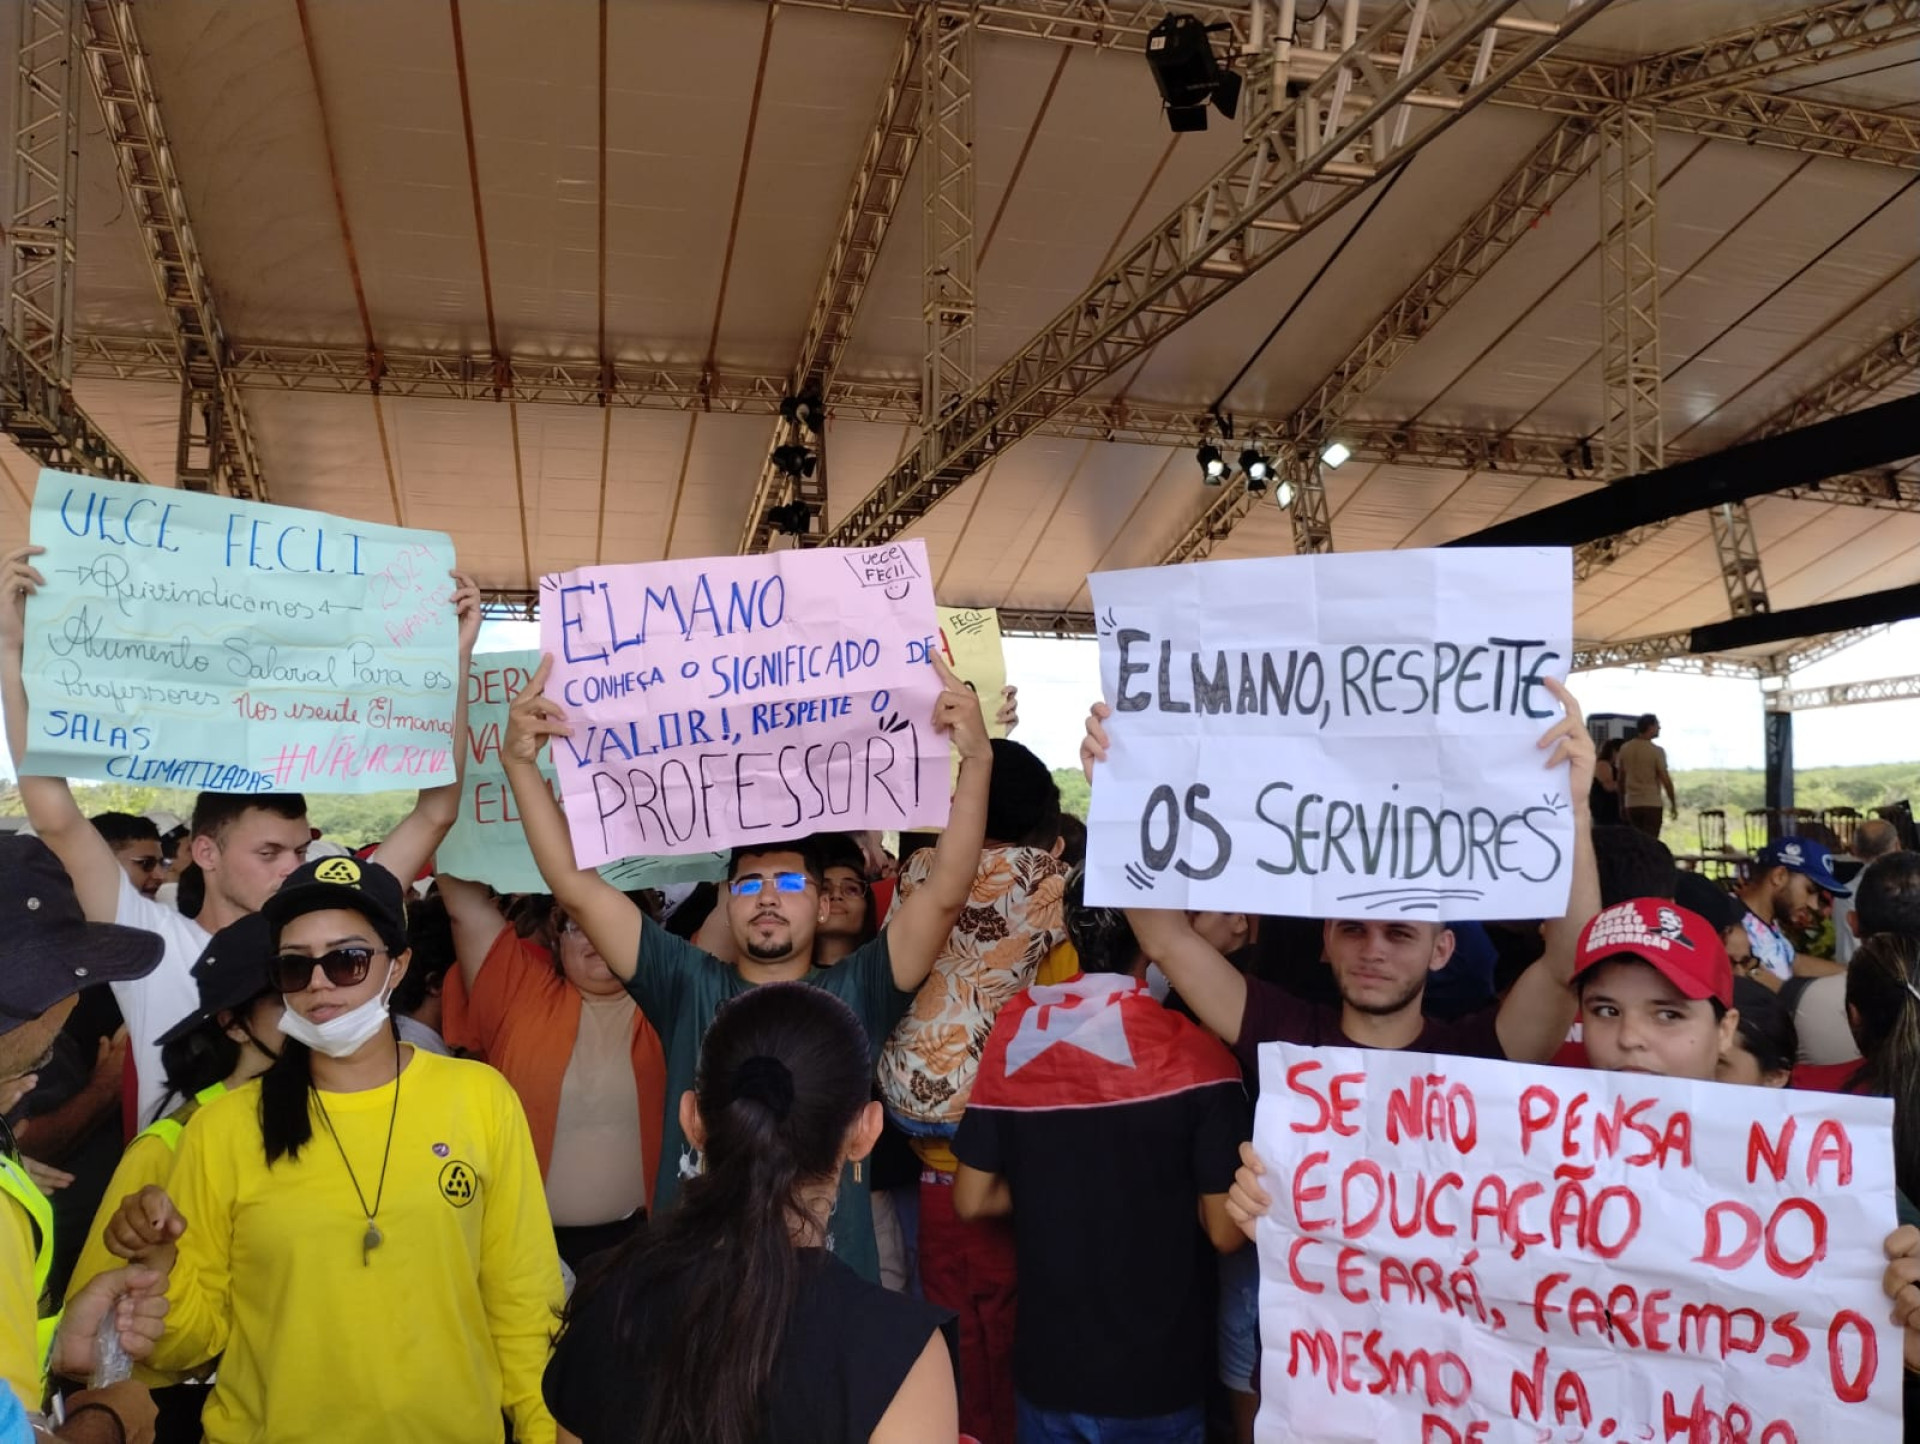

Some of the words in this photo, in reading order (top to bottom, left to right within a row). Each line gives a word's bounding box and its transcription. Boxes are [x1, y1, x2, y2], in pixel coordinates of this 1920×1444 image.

[61, 489, 182, 551] UECE
[226, 513, 367, 577] FECLI
[48, 604, 209, 672] Aumento
[223, 637, 338, 687] Salarial
[347, 641, 411, 687] Para
[424, 670, 451, 688] os
[561, 573, 785, 665] ELMANO
[564, 666, 665, 707] CONHEÇA
[708, 638, 881, 698] SIGNIFICADO
[906, 635, 936, 664] DE
[752, 695, 852, 735] RESPEITE
[870, 689, 890, 713] O
[1116, 629, 1328, 729] ELMANO,
[1340, 637, 1560, 718] RESPEITE
[43, 710, 151, 750] SALAS
[107, 755, 276, 791] CLIMATIZADAS
[1140, 782, 1232, 880] OS
[1286, 1060, 1367, 1136] SE
[1385, 1074, 1478, 1154] NÃO
[1519, 1084, 1694, 1169] PENSA
[1747, 1114, 1853, 1187] NA
[1292, 1151, 1641, 1261] EDUCAÇÃO
[1692, 1196, 1828, 1279] DO
[1287, 1237, 1507, 1330] CEARÁ,
[1520, 1271, 1811, 1369] FAREMOS
[1827, 1308, 1878, 1404] O
[1286, 1329, 1473, 1409] MESMO
